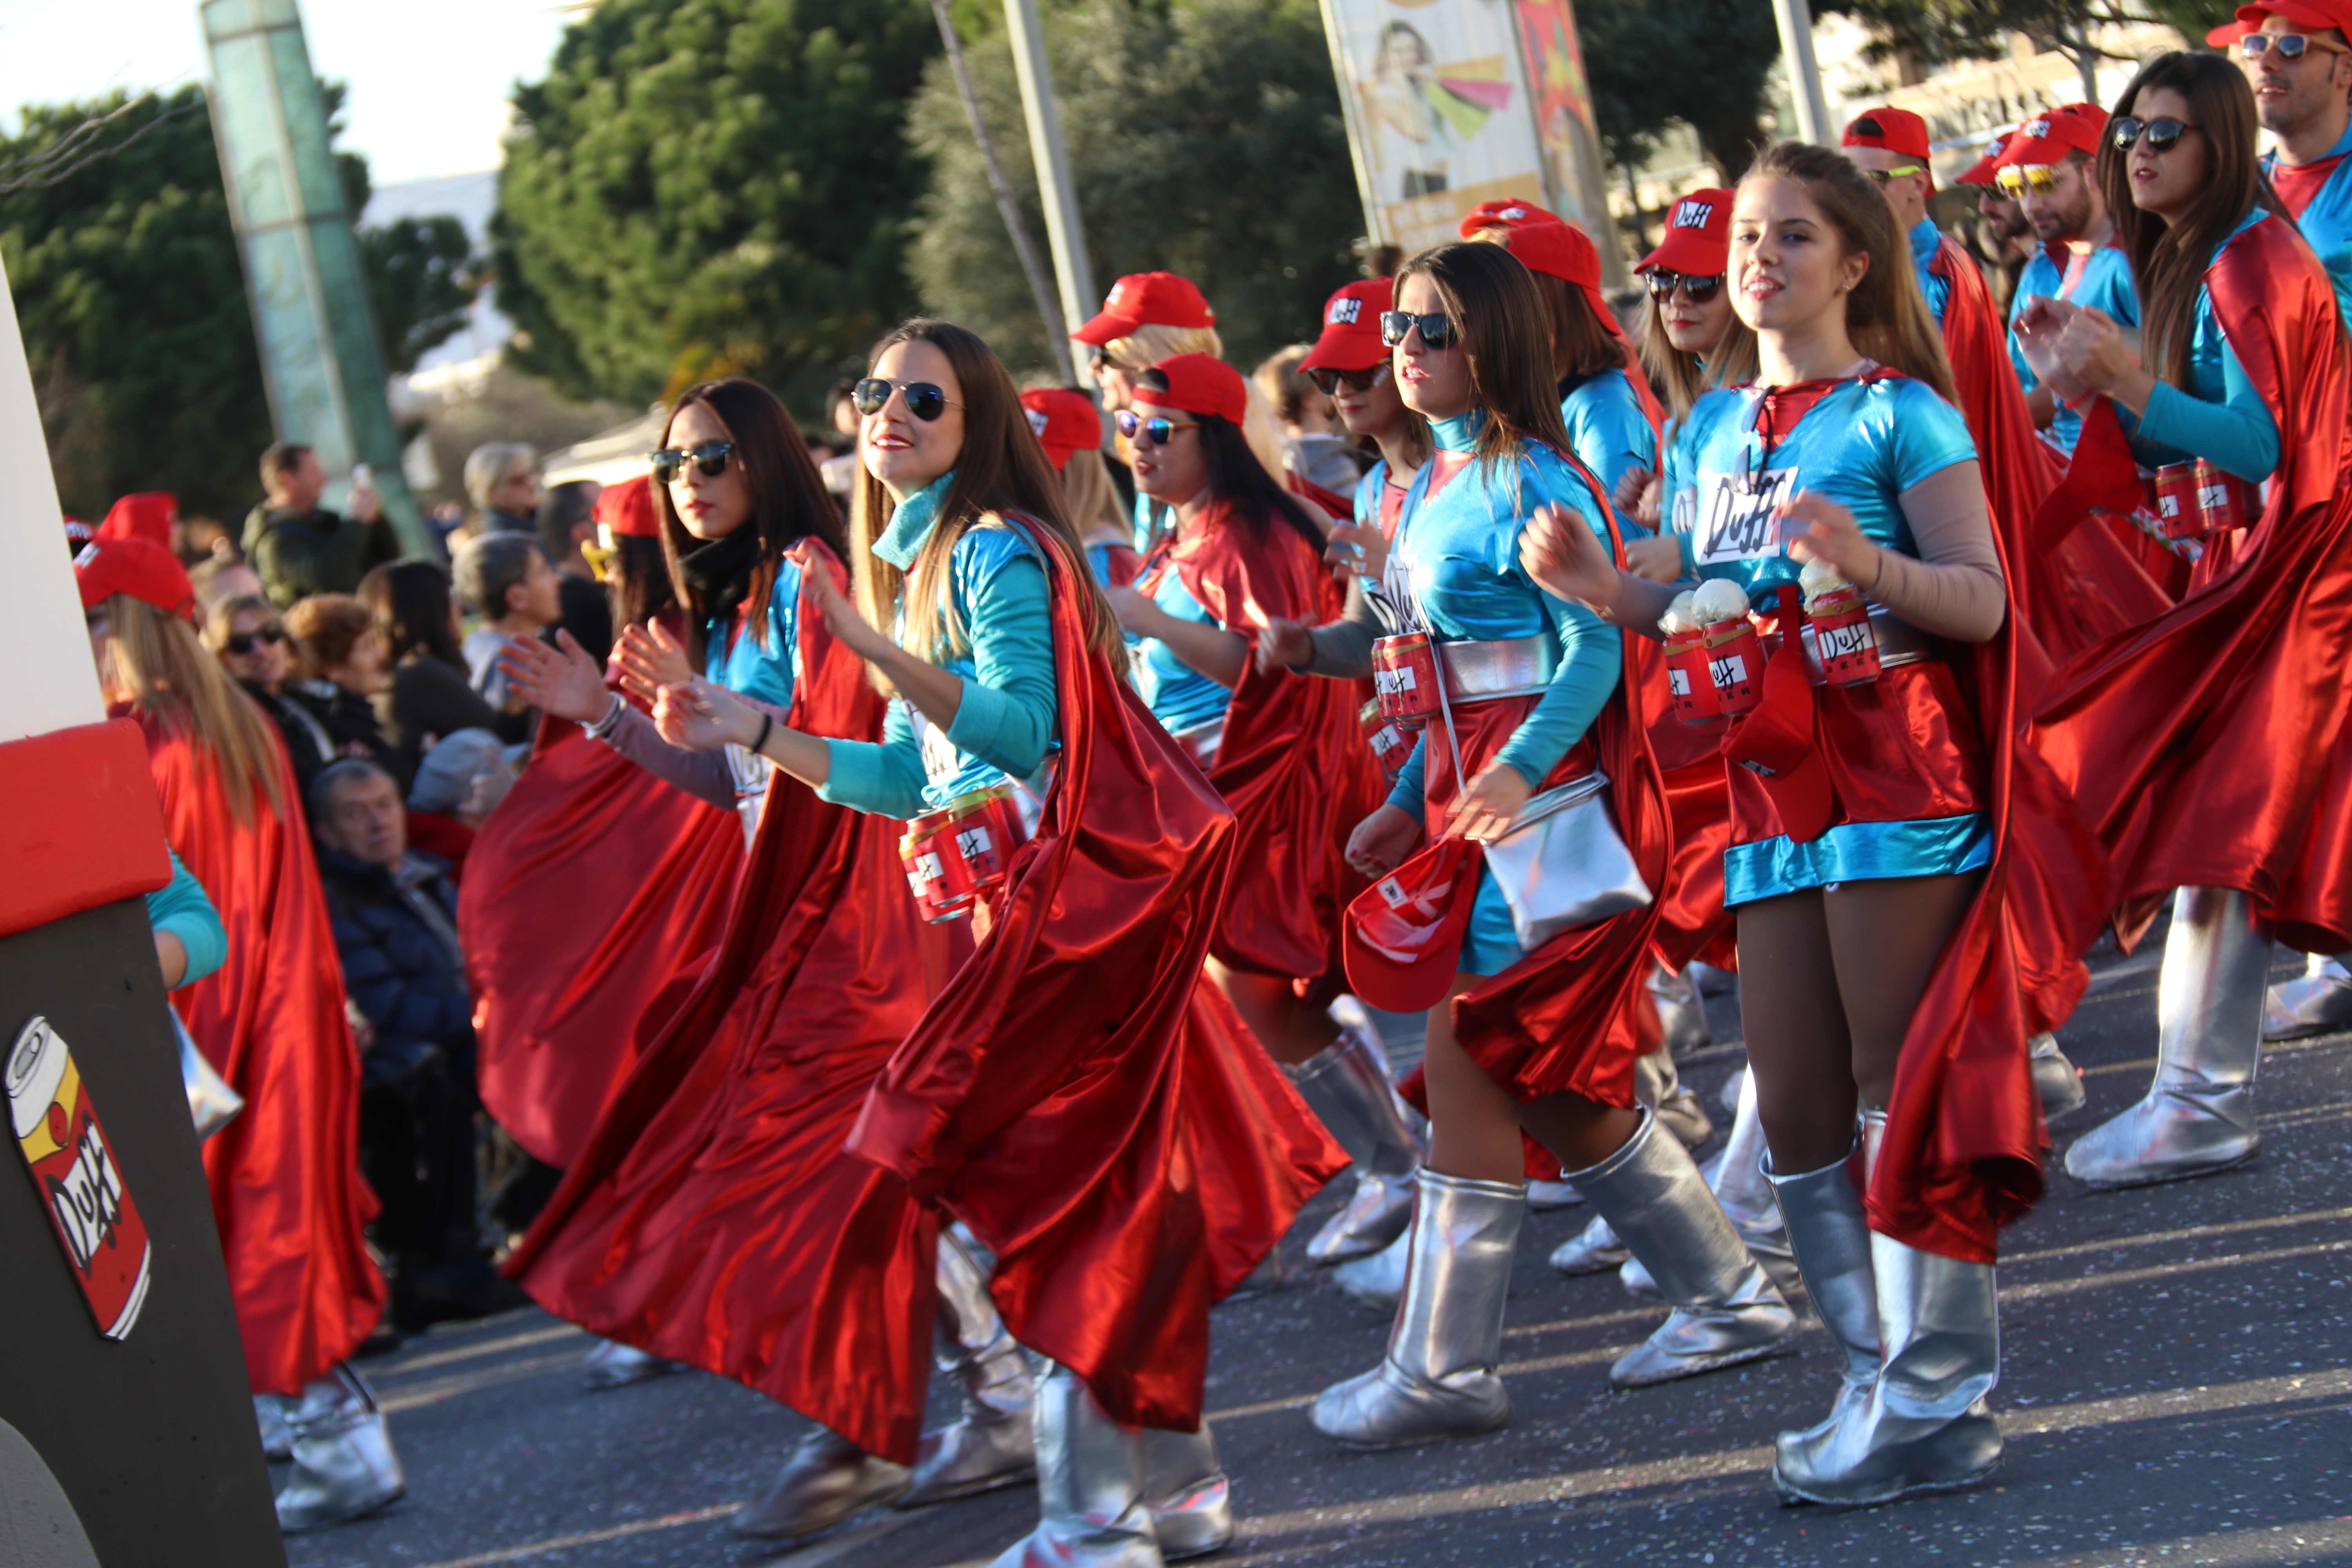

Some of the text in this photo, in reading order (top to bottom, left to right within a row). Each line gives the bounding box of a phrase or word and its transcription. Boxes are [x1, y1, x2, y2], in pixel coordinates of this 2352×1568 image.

[1672, 200, 1713, 229] Duff
[1704, 475, 1786, 558] Duff
[1822, 621, 1864, 662] Duff
[1709, 654, 1734, 691] uff
[44, 1111, 121, 1281] Duff
